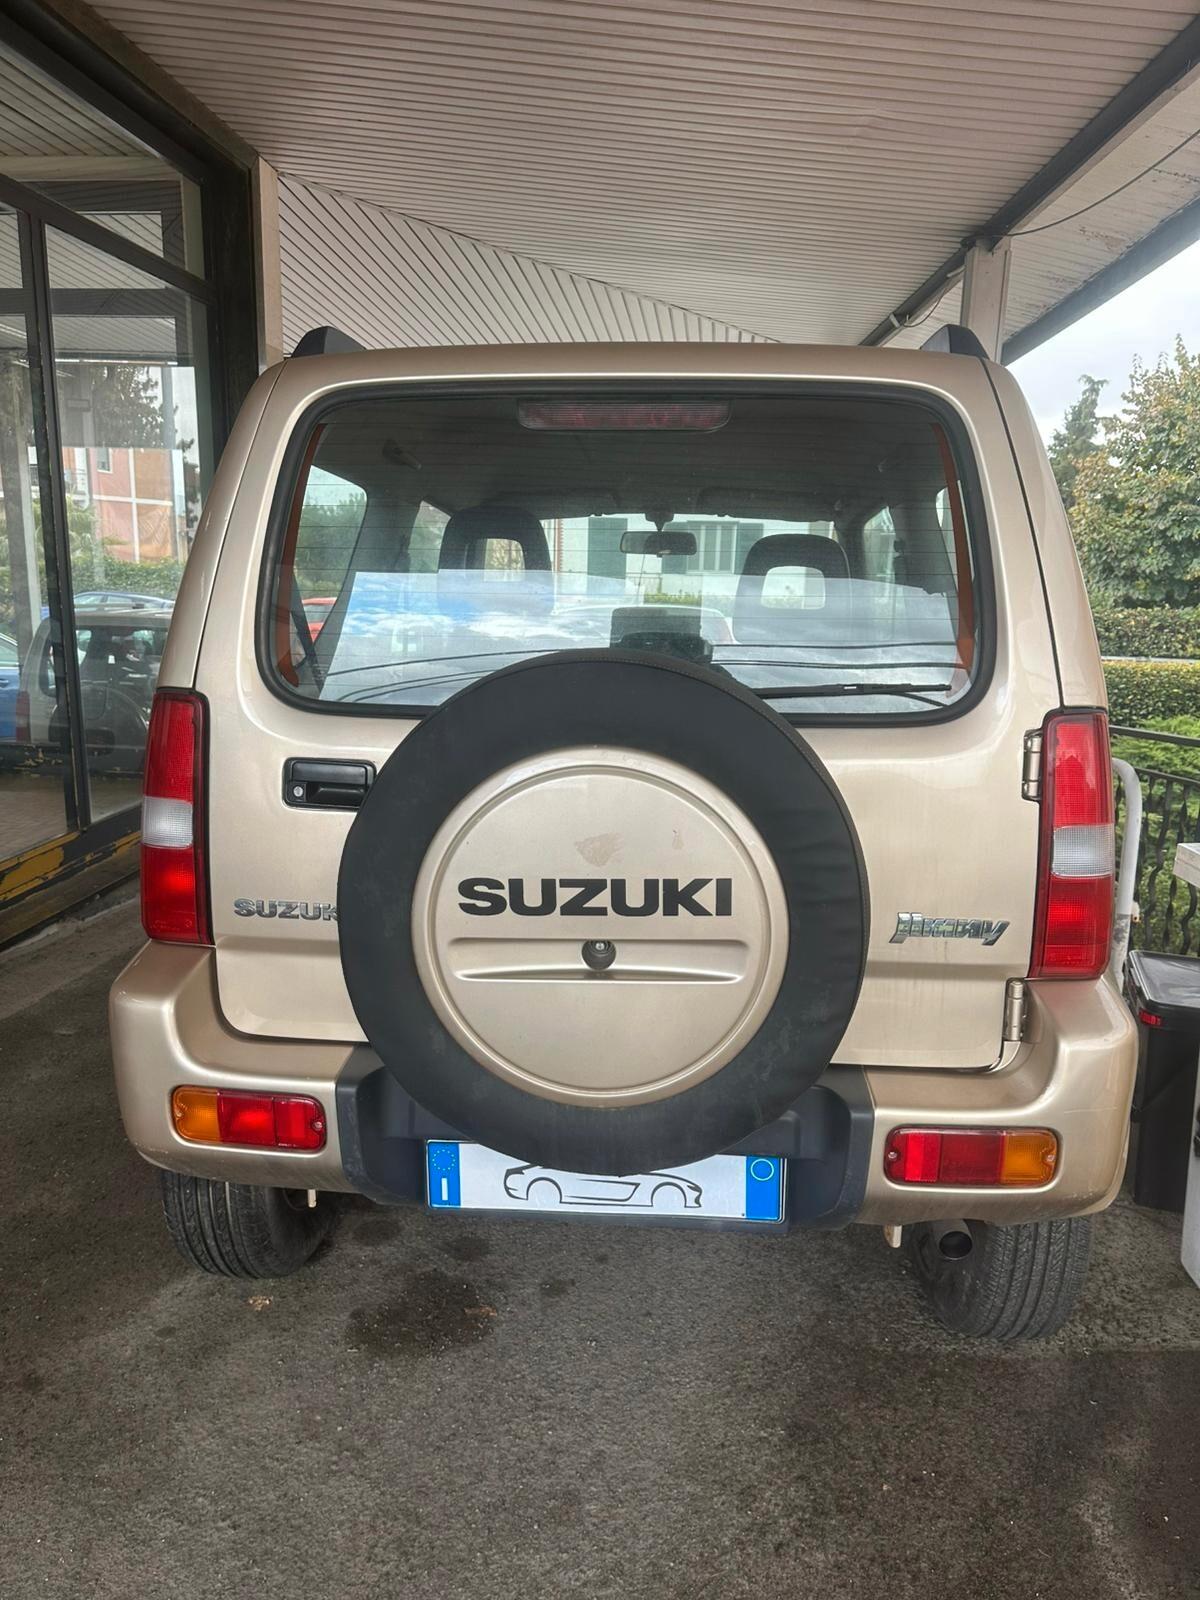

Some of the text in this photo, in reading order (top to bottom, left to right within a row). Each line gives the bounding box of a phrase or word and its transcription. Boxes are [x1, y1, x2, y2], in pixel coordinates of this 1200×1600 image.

[458, 878, 732, 917] SUZUKI
[889, 911, 1010, 946] Jimny
[441, 1177, 448, 1201] I
